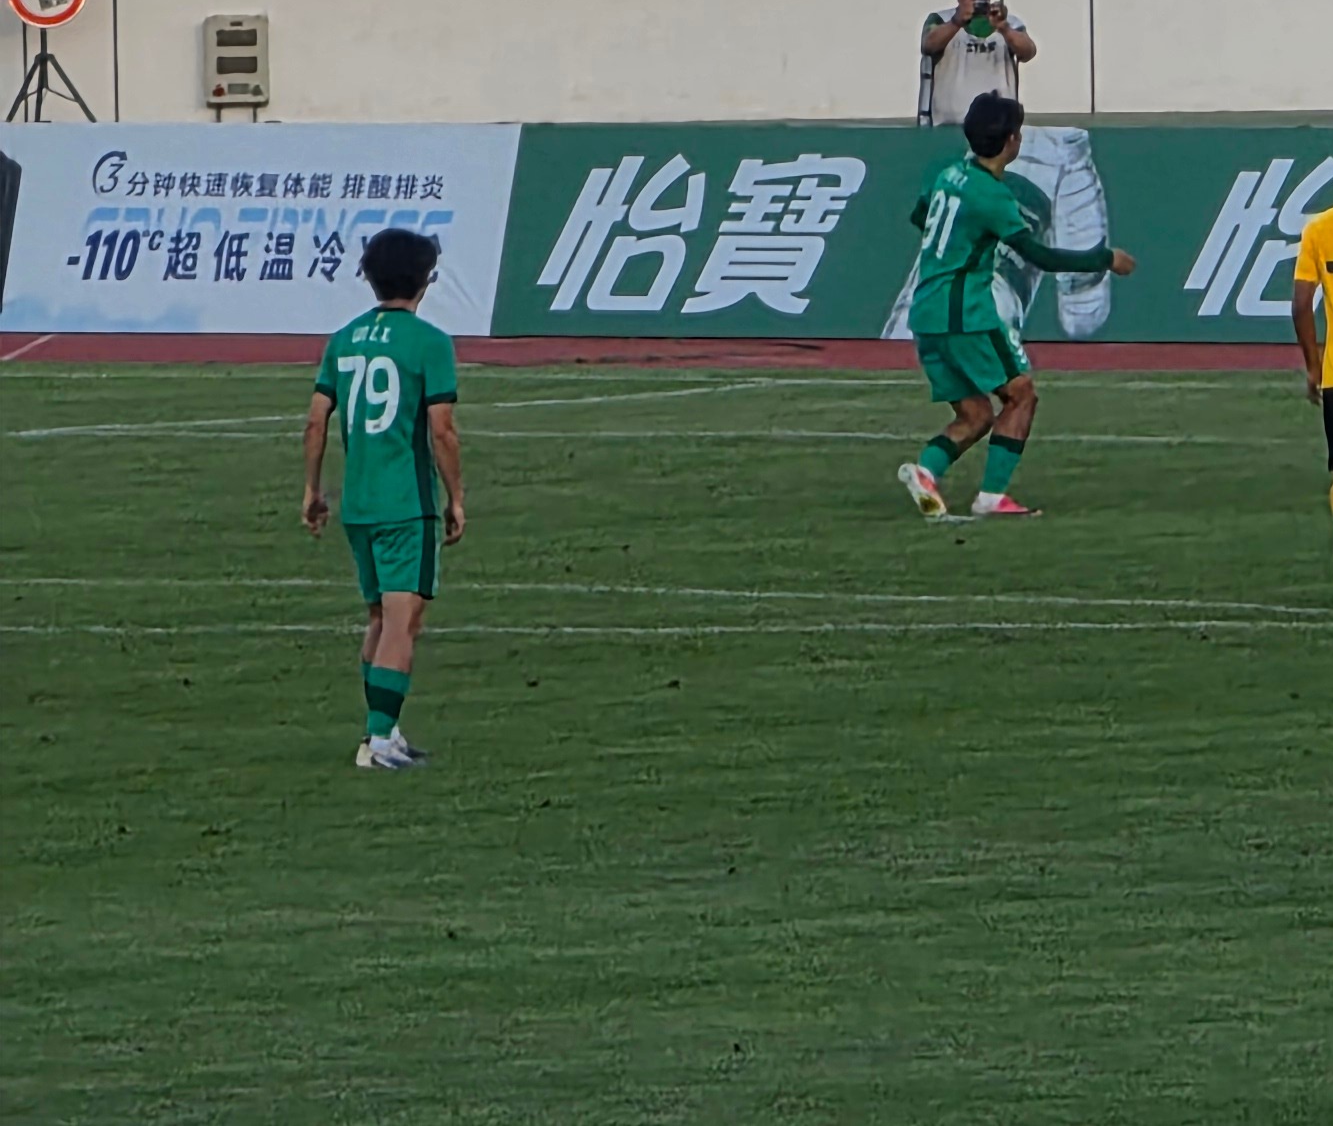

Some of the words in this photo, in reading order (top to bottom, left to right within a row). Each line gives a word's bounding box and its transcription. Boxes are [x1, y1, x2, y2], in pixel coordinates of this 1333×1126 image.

[340, 173, 444, 199] 排酸排炎
[537, 154, 866, 314] 怡寶
[922, 189, 961, 259] 91
[337, 355, 400, 436] 79
